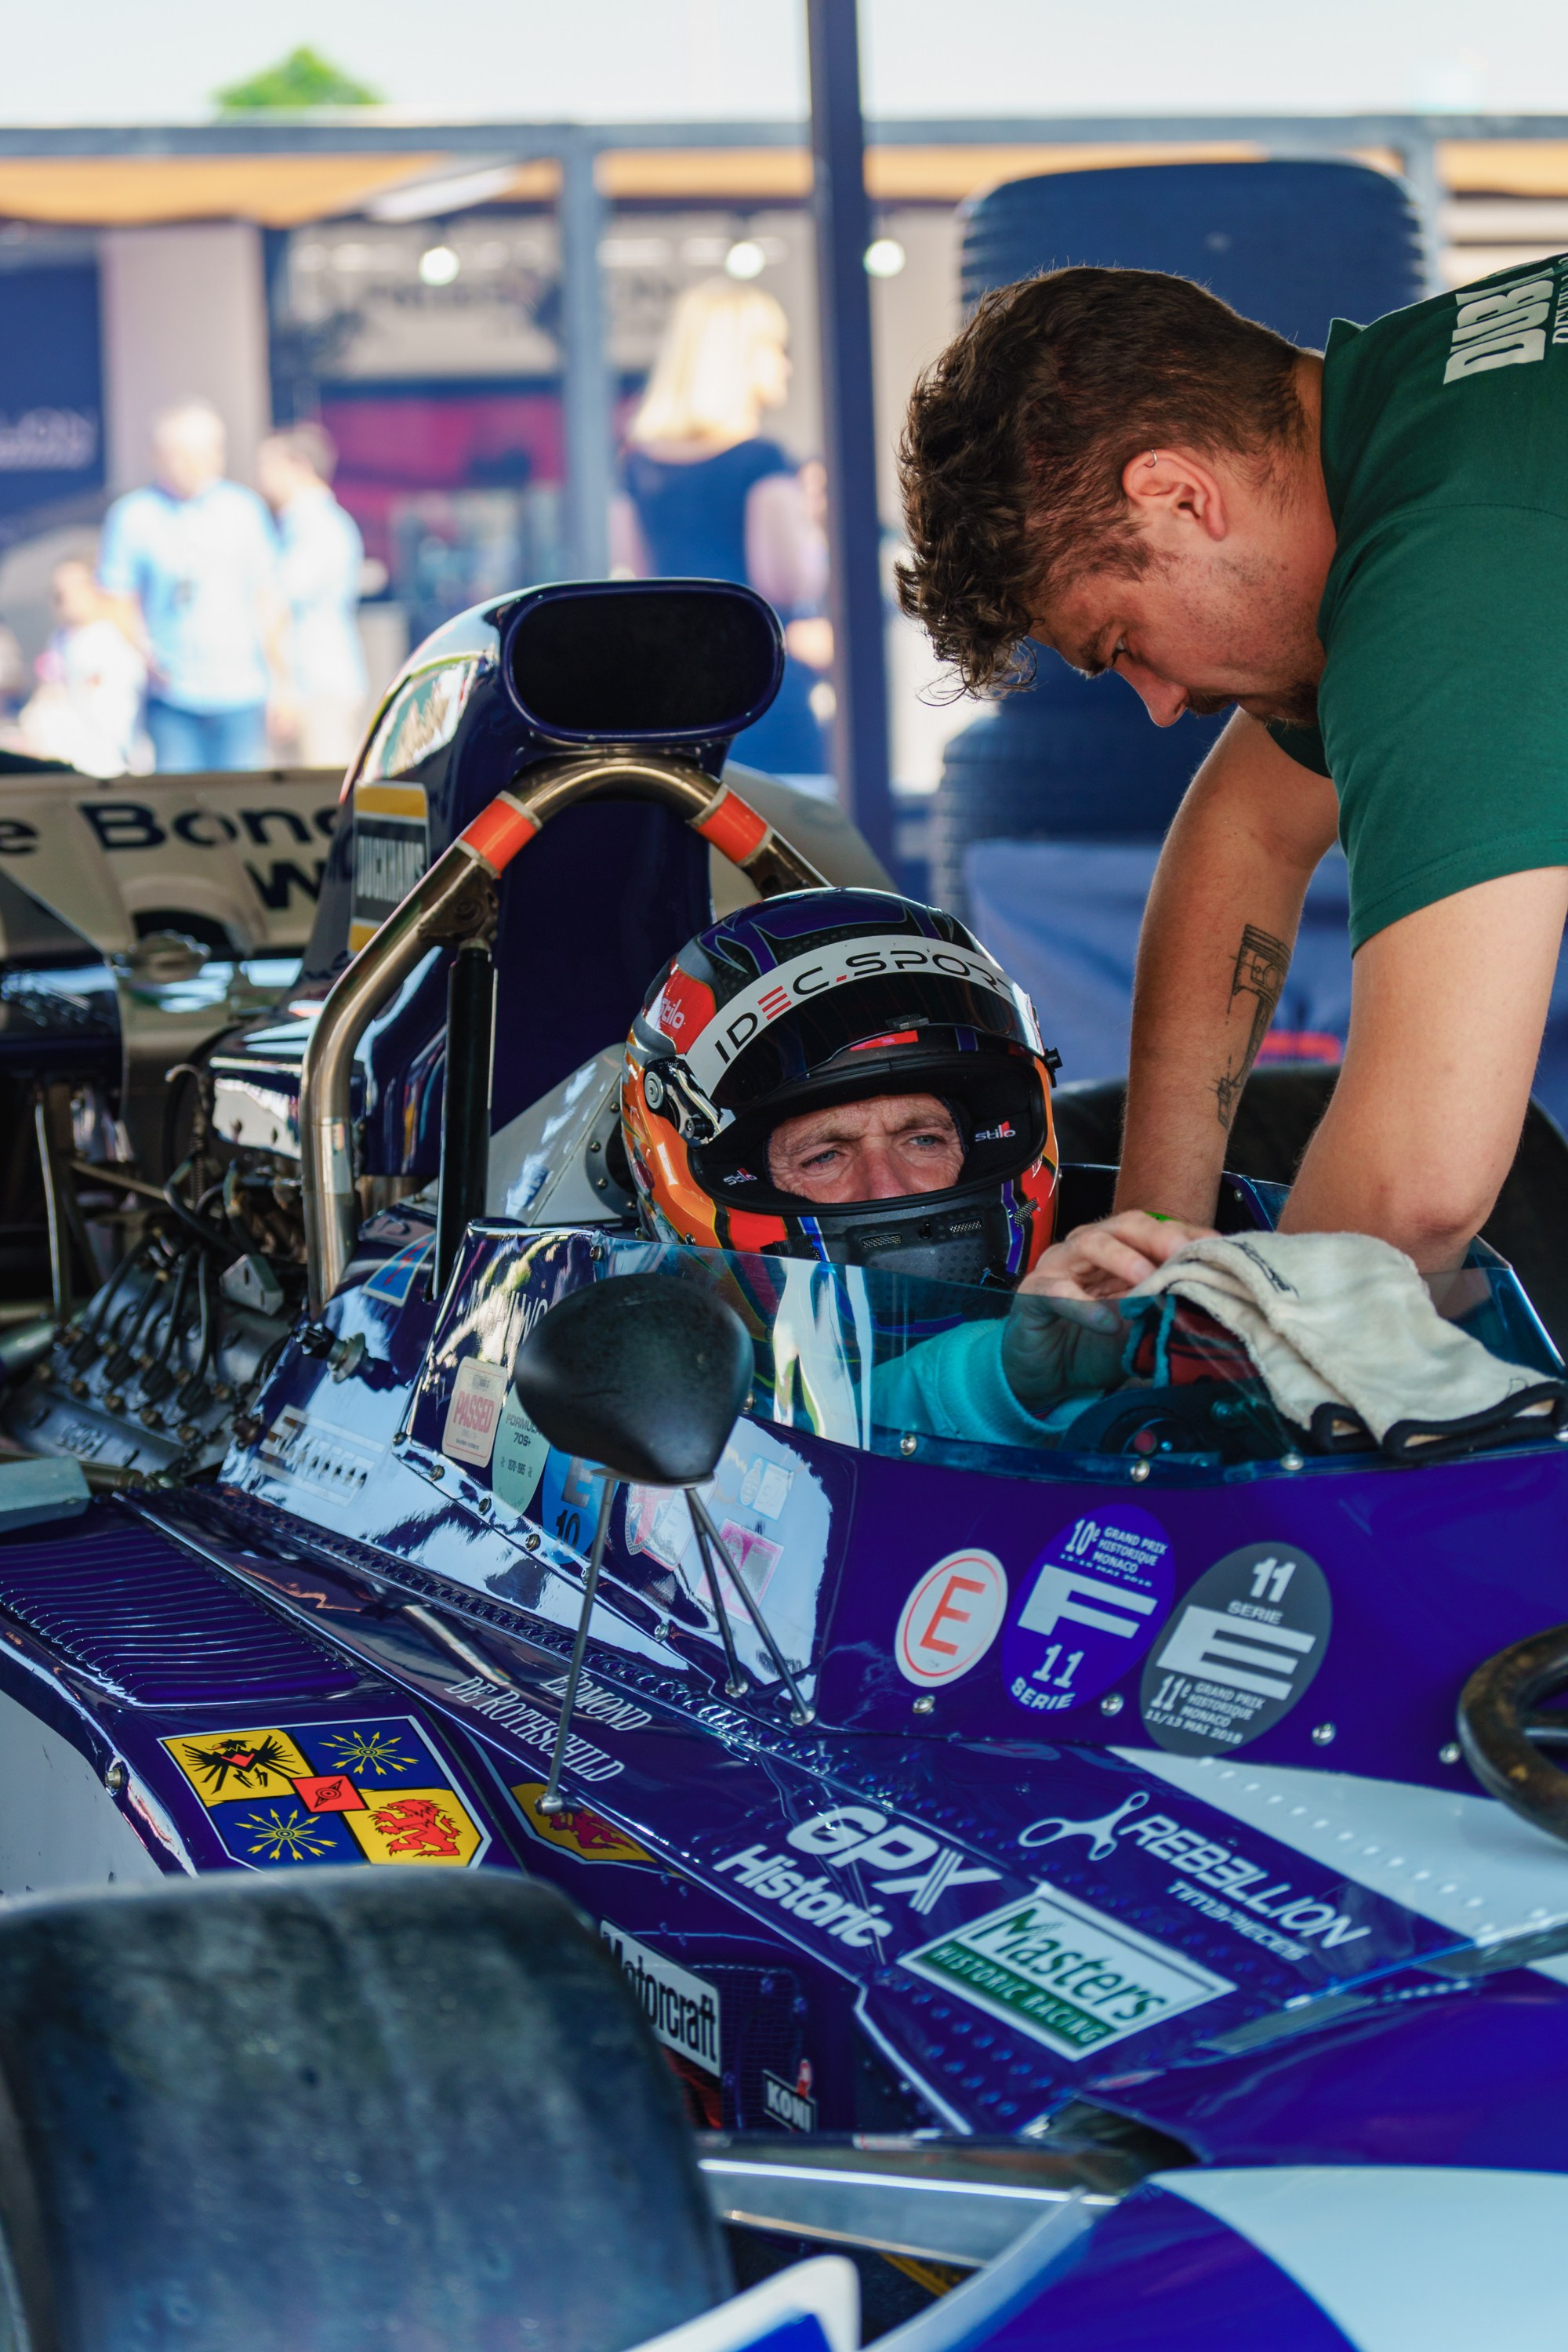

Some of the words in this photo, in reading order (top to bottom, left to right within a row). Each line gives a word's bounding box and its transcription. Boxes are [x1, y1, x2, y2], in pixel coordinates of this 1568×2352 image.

[453, 1391, 495, 1434] PASSED
[554, 1510, 582, 1557] 10
[1098, 1539, 1159, 1566] HISTORIQUE
[1104, 1526, 1139, 1545] GRAND
[1141, 1538, 1168, 1555] PRIX
[1092, 1552, 1138, 1573] MONACO
[1249, 1557, 1296, 1602] 11
[920, 1575, 986, 1656] E
[1017, 1563, 1158, 1639] F
[1227, 1600, 1283, 1625] SERIE
[1031, 1643, 1084, 1689] 11
[1156, 1605, 1316, 1700] E
[1011, 1676, 1076, 1711] SERIE
[1187, 1693, 1255, 1722] HISTORIQUE
[1194, 1683, 1236, 1702] GRAND
[1236, 1693, 1267, 1711] PRIX
[444, 1675, 499, 1704] DE
[472, 1690, 625, 1782] ROTHSCHILD
[1180, 1706, 1232, 1728] MONACO
[1182, 1719, 1210, 1736] MAI
[1210, 1727, 1244, 1745] 2018
[786, 1806, 1003, 1915] GPX
[712, 1843, 894, 1948] Historic
[931, 1940, 1030, 2000] HISTORIC
[969, 1907, 1168, 2020] Masters
[1023, 1991, 1109, 2042] RACING
[767, 2080, 812, 2133] KONI
